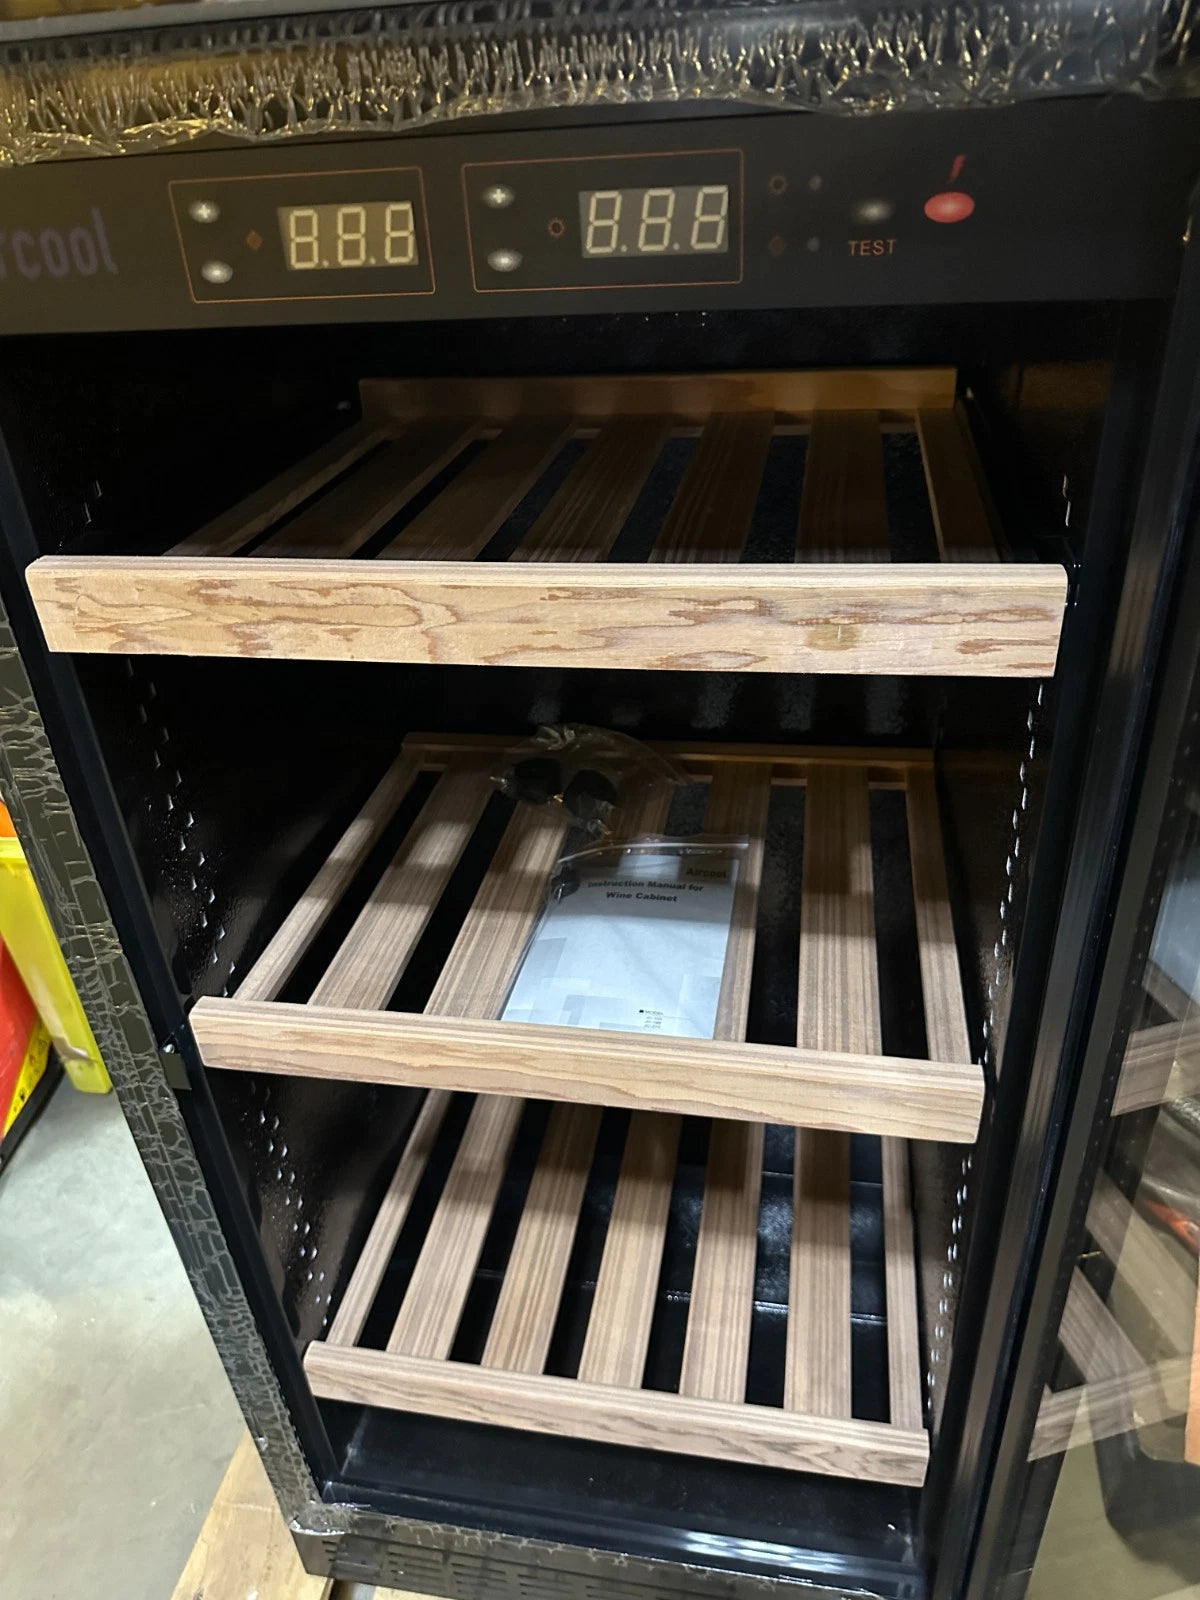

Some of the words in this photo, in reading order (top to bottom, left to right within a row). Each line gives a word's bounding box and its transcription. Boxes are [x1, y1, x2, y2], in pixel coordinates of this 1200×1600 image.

[848, 238, 897, 256] TEST
[685, 867, 727, 879] Aircool
[647, 880, 687, 891] Manual
[688, 883, 704, 892] for
[606, 891, 633, 899] Wine
[635, 892, 678, 902] Cabinet
